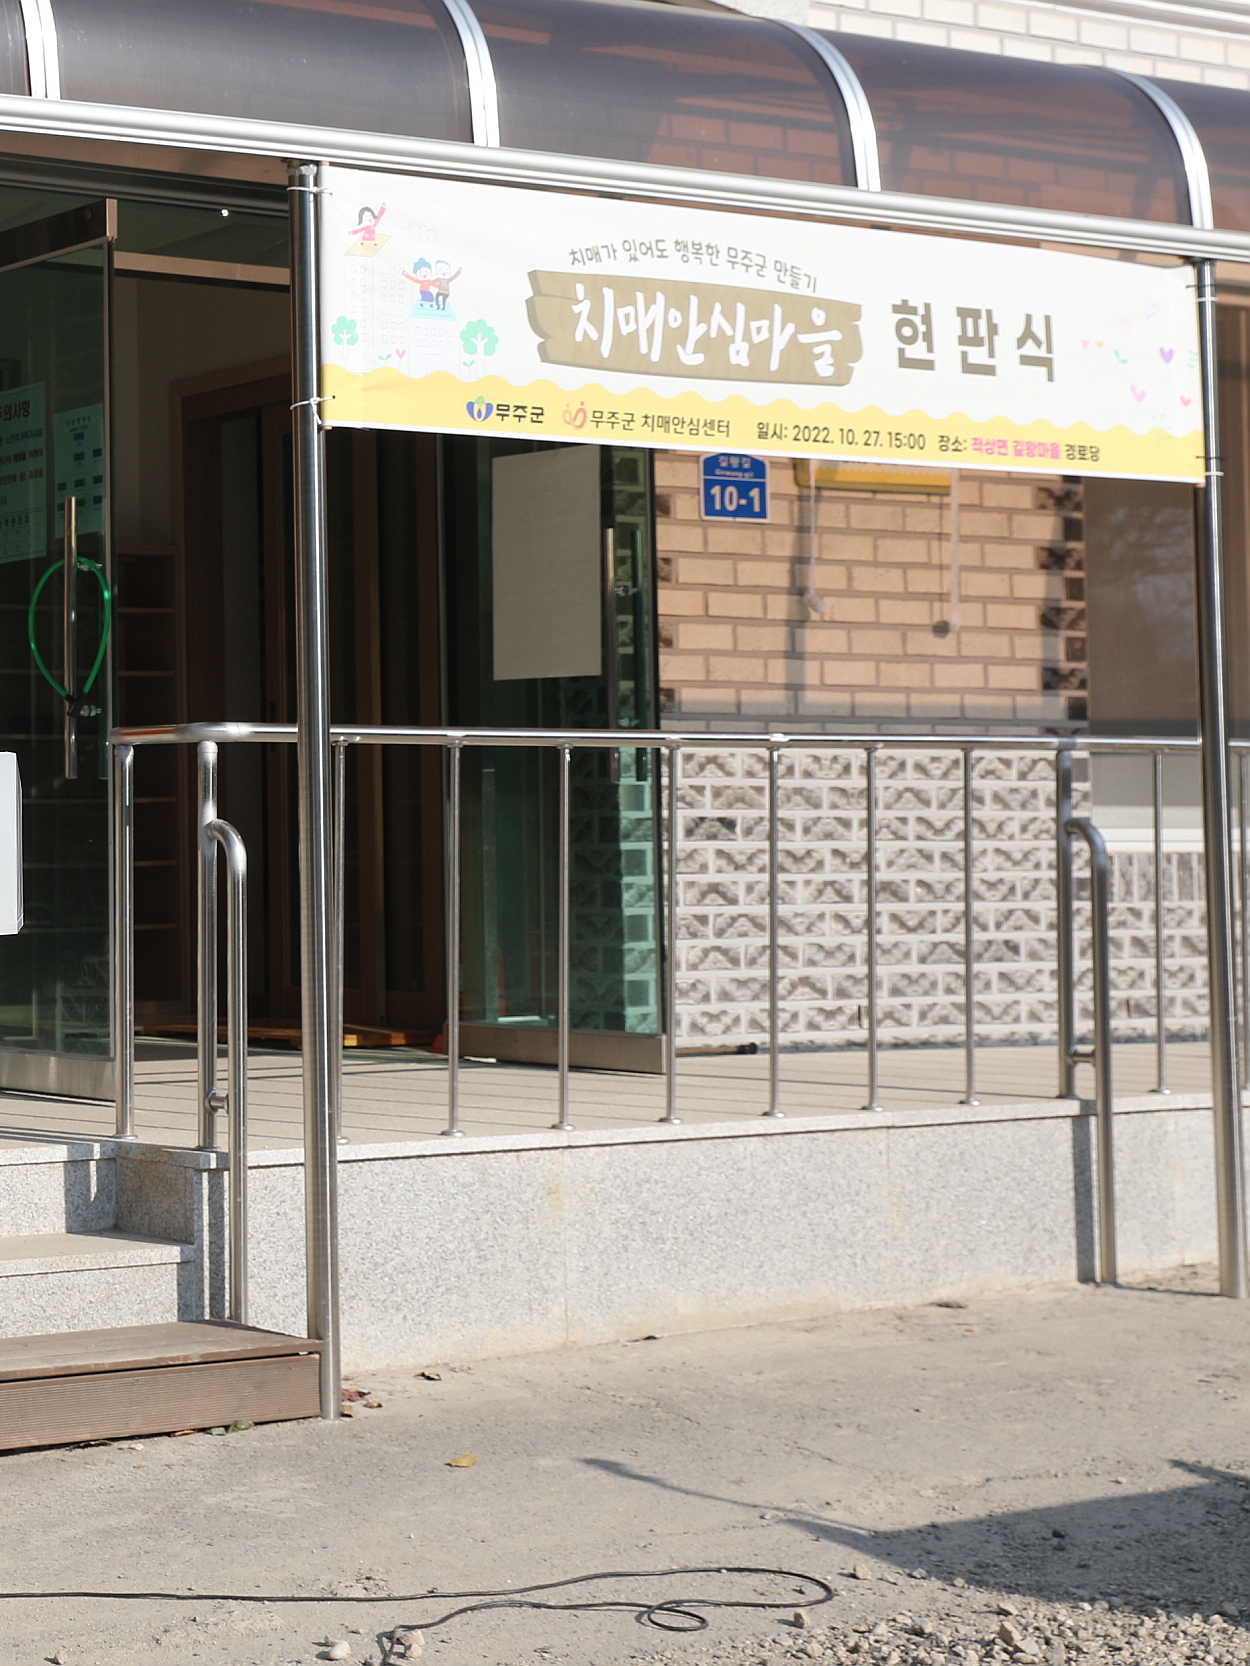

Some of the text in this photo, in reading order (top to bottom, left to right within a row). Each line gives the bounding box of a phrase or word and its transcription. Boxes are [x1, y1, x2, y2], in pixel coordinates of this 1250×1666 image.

[569, 238, 818, 293] 치매가 있어도 행복한 무주군 만들기
[571, 282, 844, 379] 치매안심마을
[495, 402, 546, 425] 무주군
[589, 409, 731, 438] 무주군 치매안심센터
[756, 421, 927, 450] 일시: 2022. 10. 27. 15:00
[937, 434, 968, 453] 장소:
[1064, 443, 1101, 463] 경로당
[710, 484, 761, 513] 10-1
